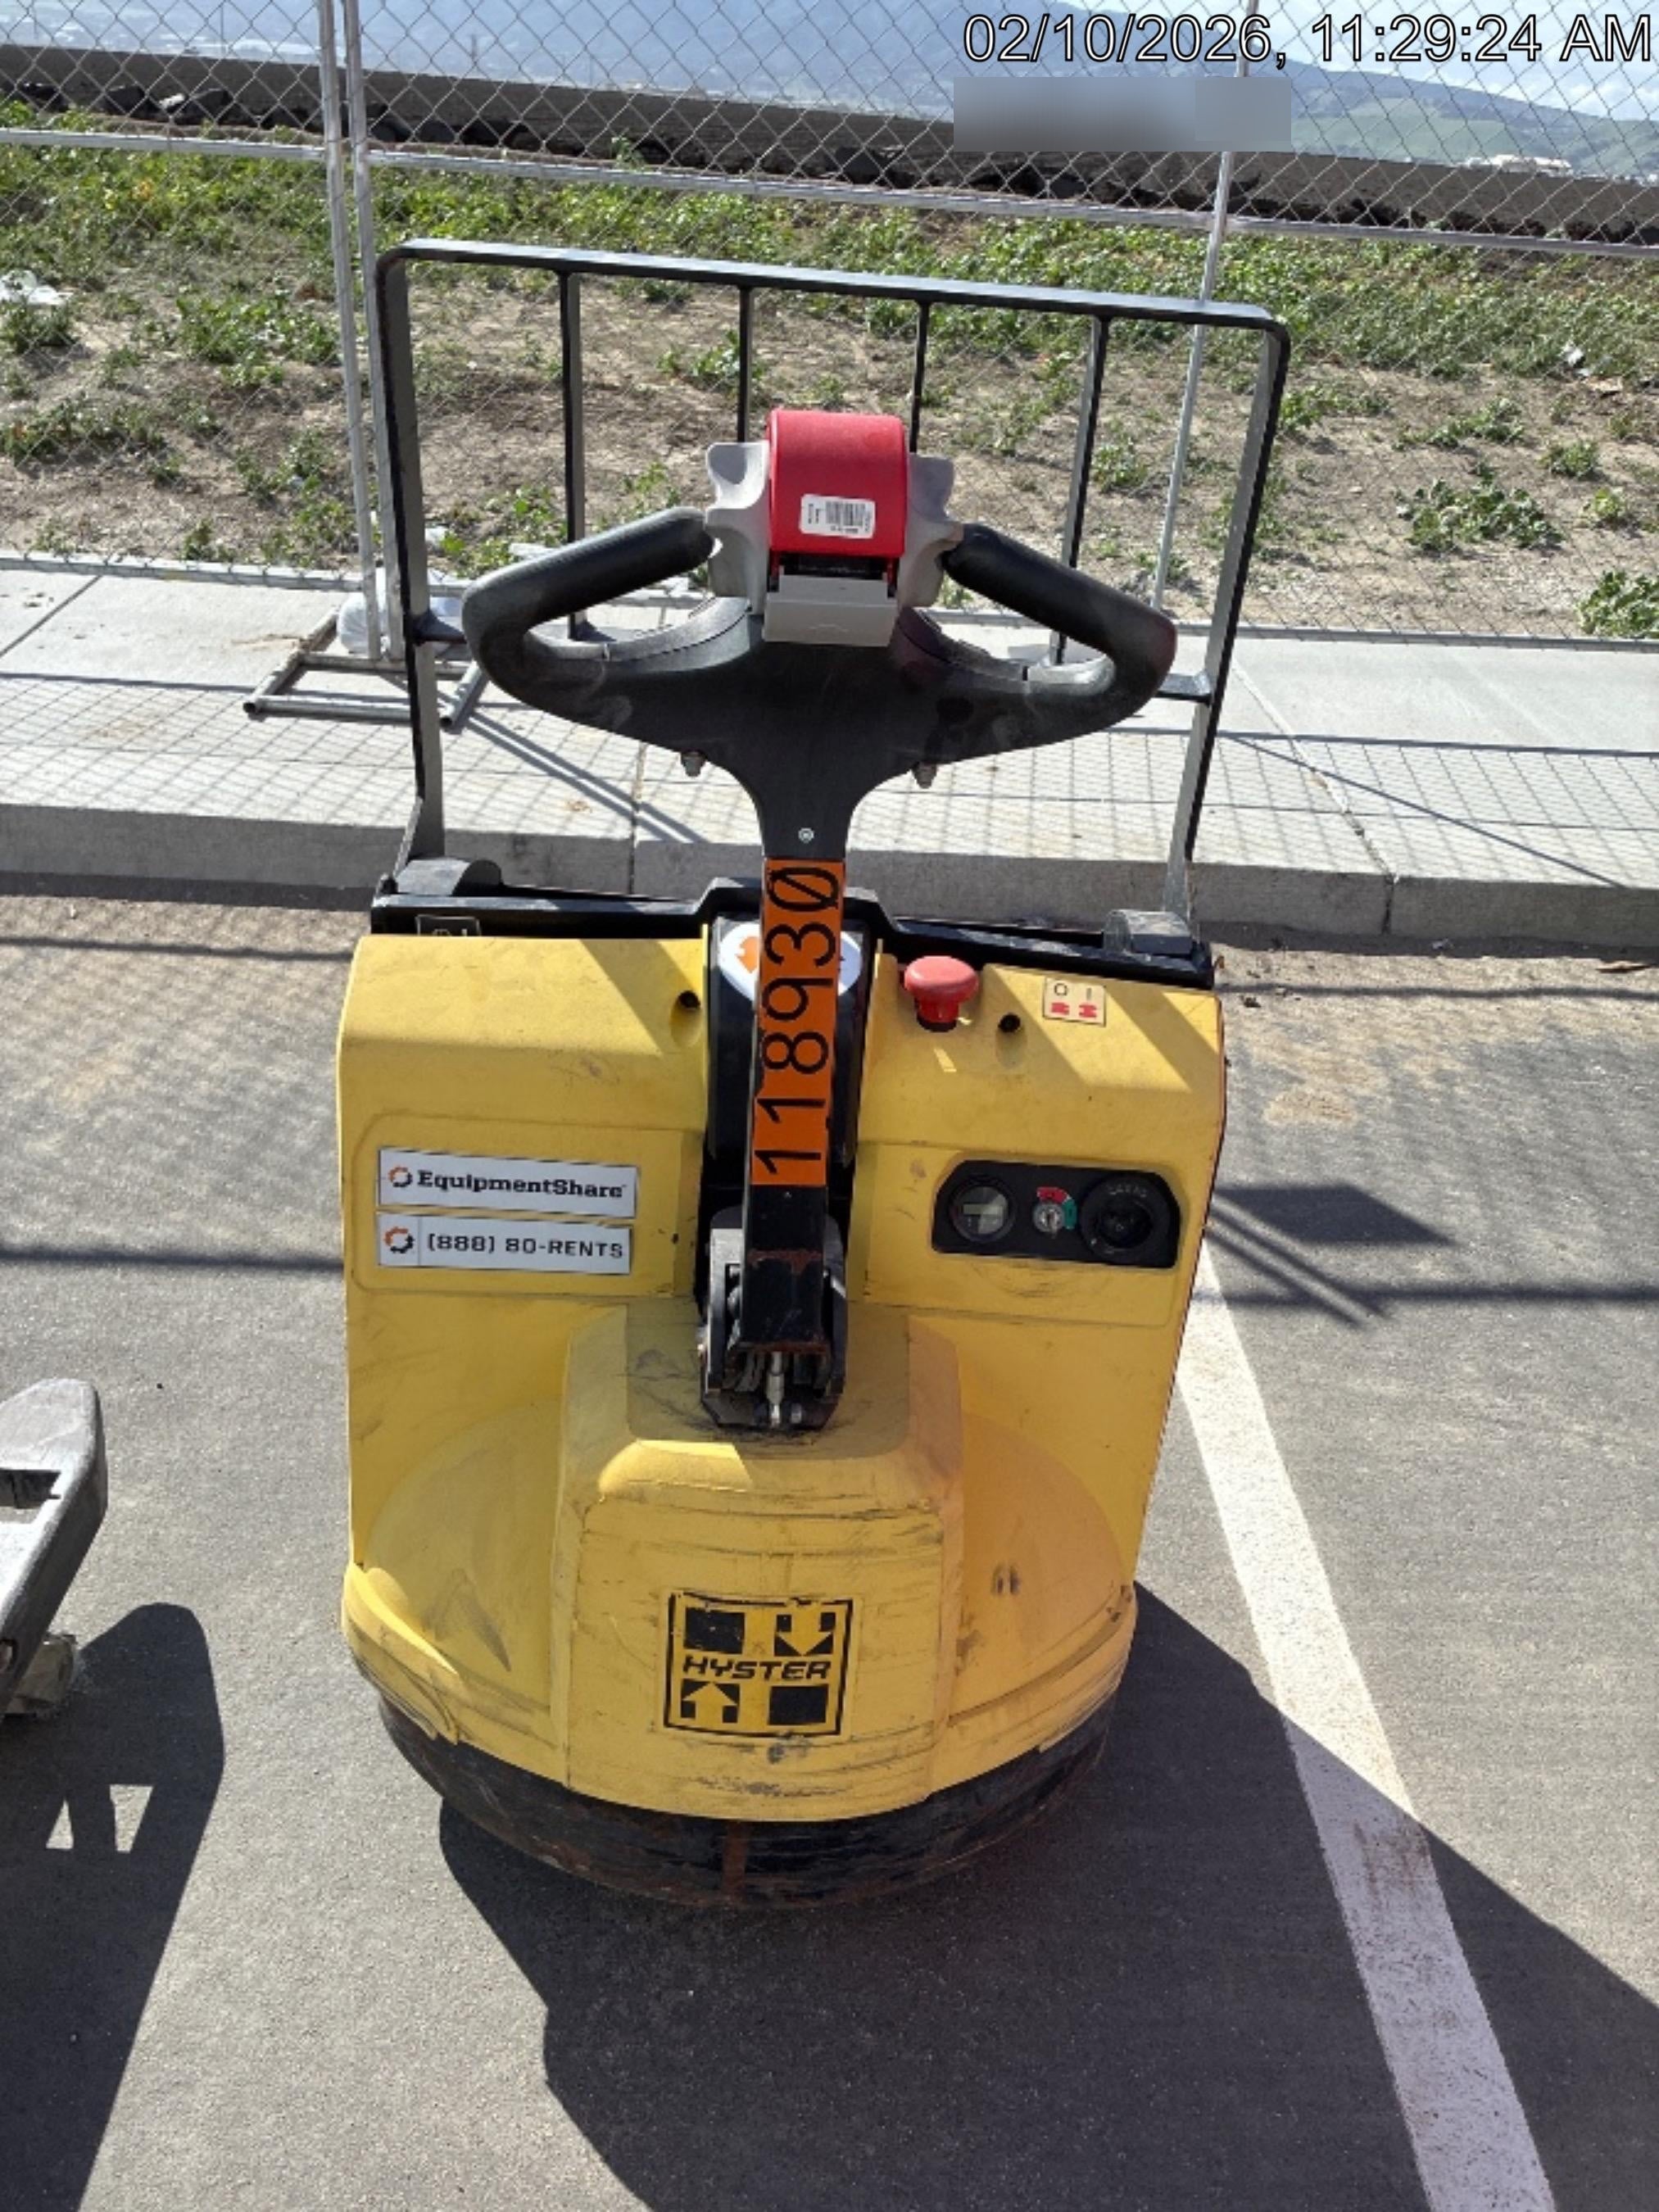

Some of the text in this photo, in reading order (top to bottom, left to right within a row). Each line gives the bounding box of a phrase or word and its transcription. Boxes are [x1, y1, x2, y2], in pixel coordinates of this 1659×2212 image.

[754, 866, 841, 1176] 118930
[417, 1169, 624, 1199] EquipmentShare
[427, 1233, 623, 1258] (888) 80-RENTS
[682, 1654, 832, 1680] HYSTER
